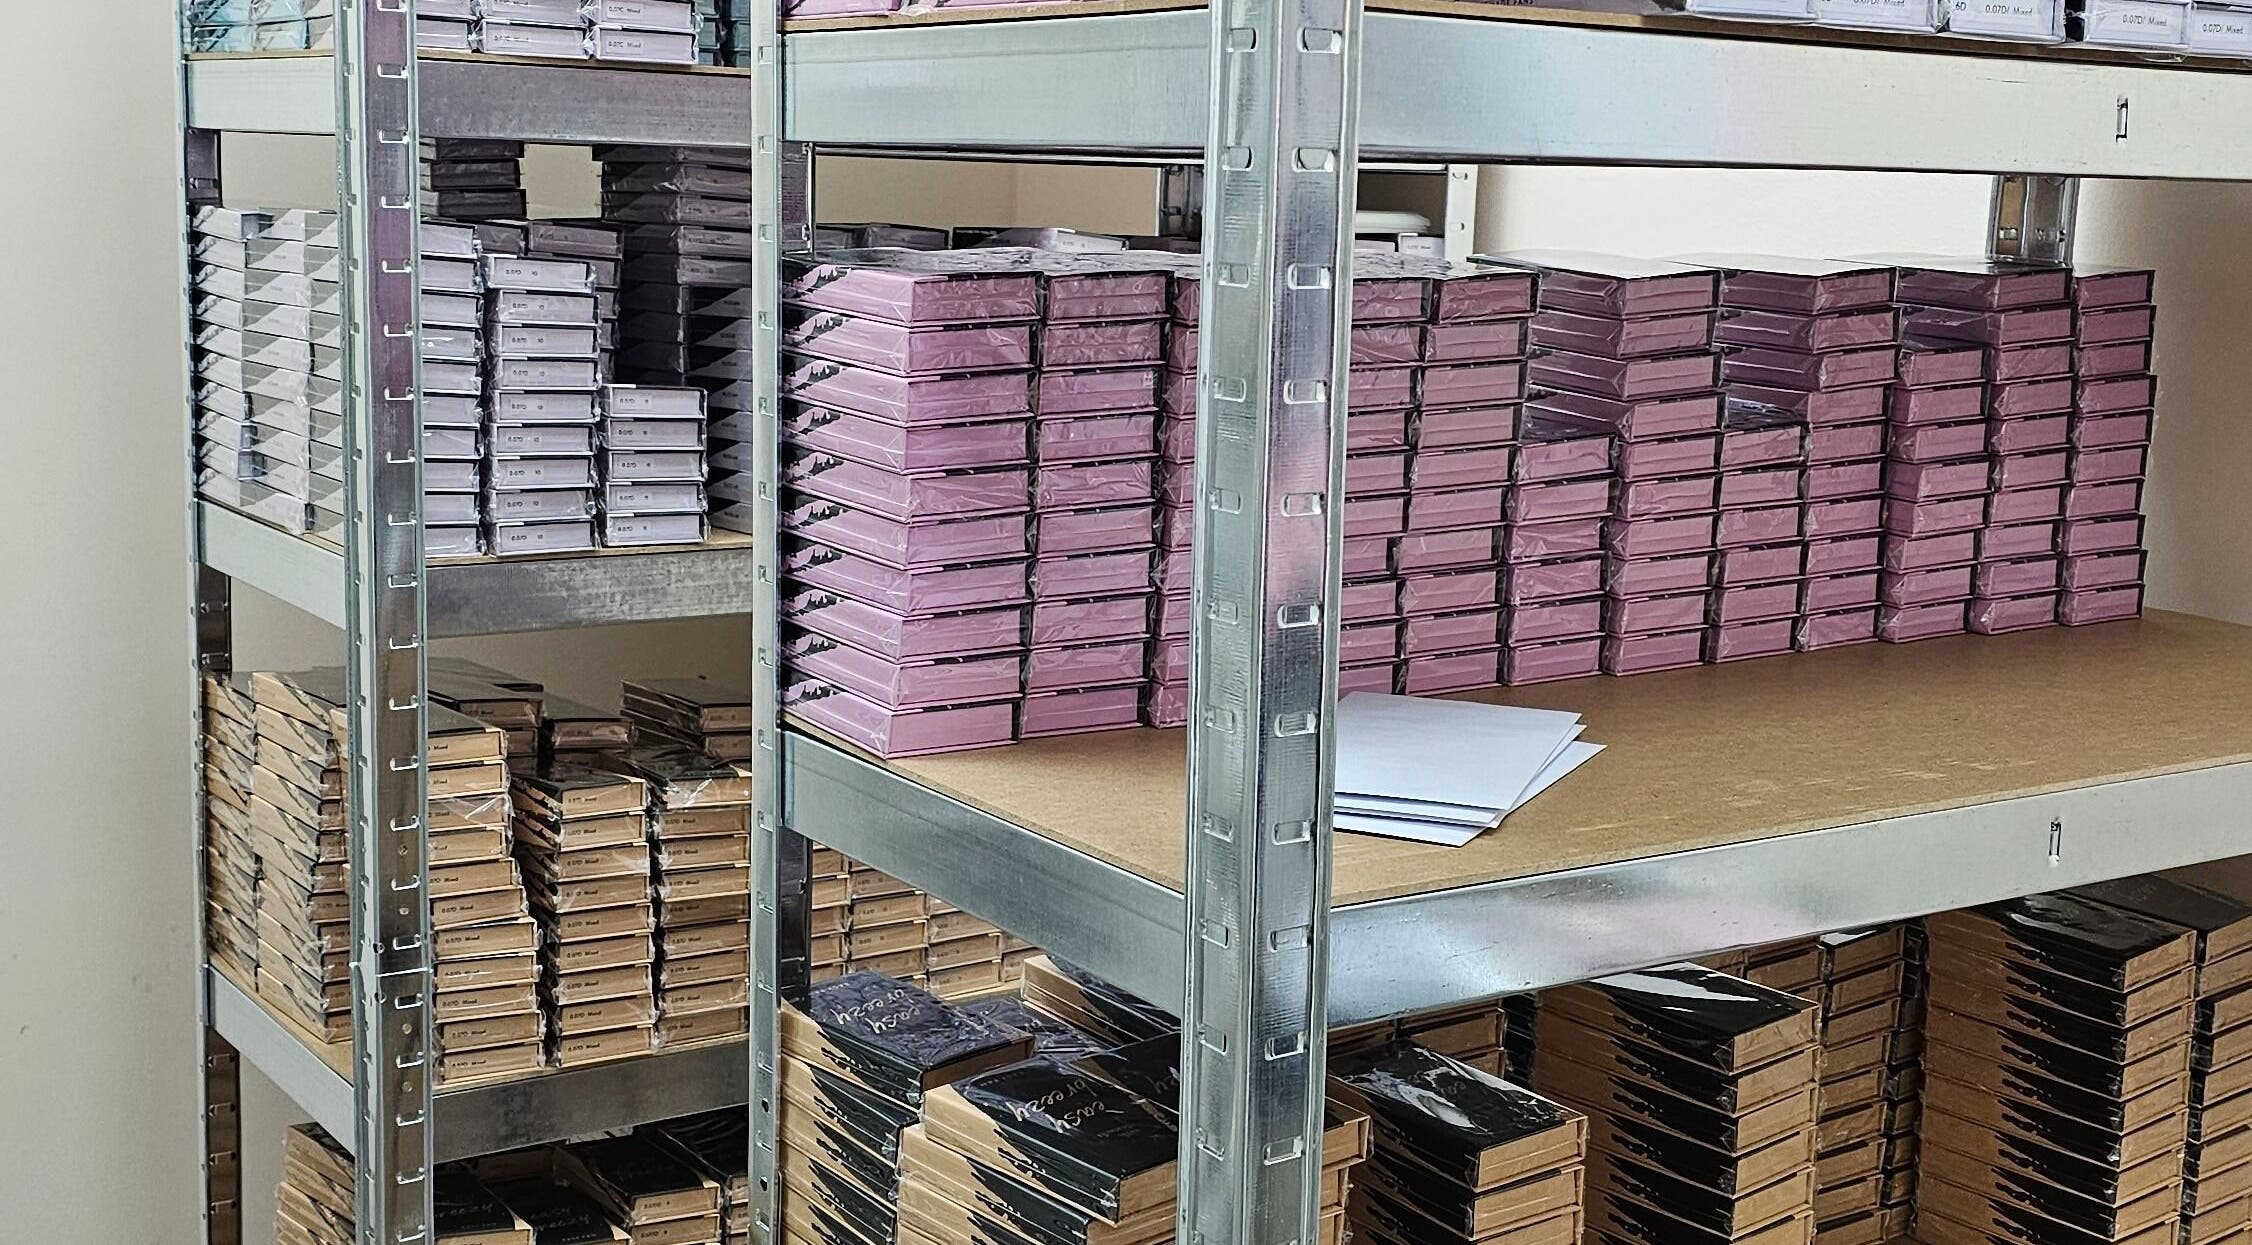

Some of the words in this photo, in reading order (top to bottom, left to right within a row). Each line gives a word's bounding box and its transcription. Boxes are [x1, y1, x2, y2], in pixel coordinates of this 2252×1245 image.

[830, 989, 914, 1025] breezy
[865, 1006, 920, 1034] easy
[1006, 1079, 1097, 1122] breezy
[1046, 1101, 1105, 1134] easy
